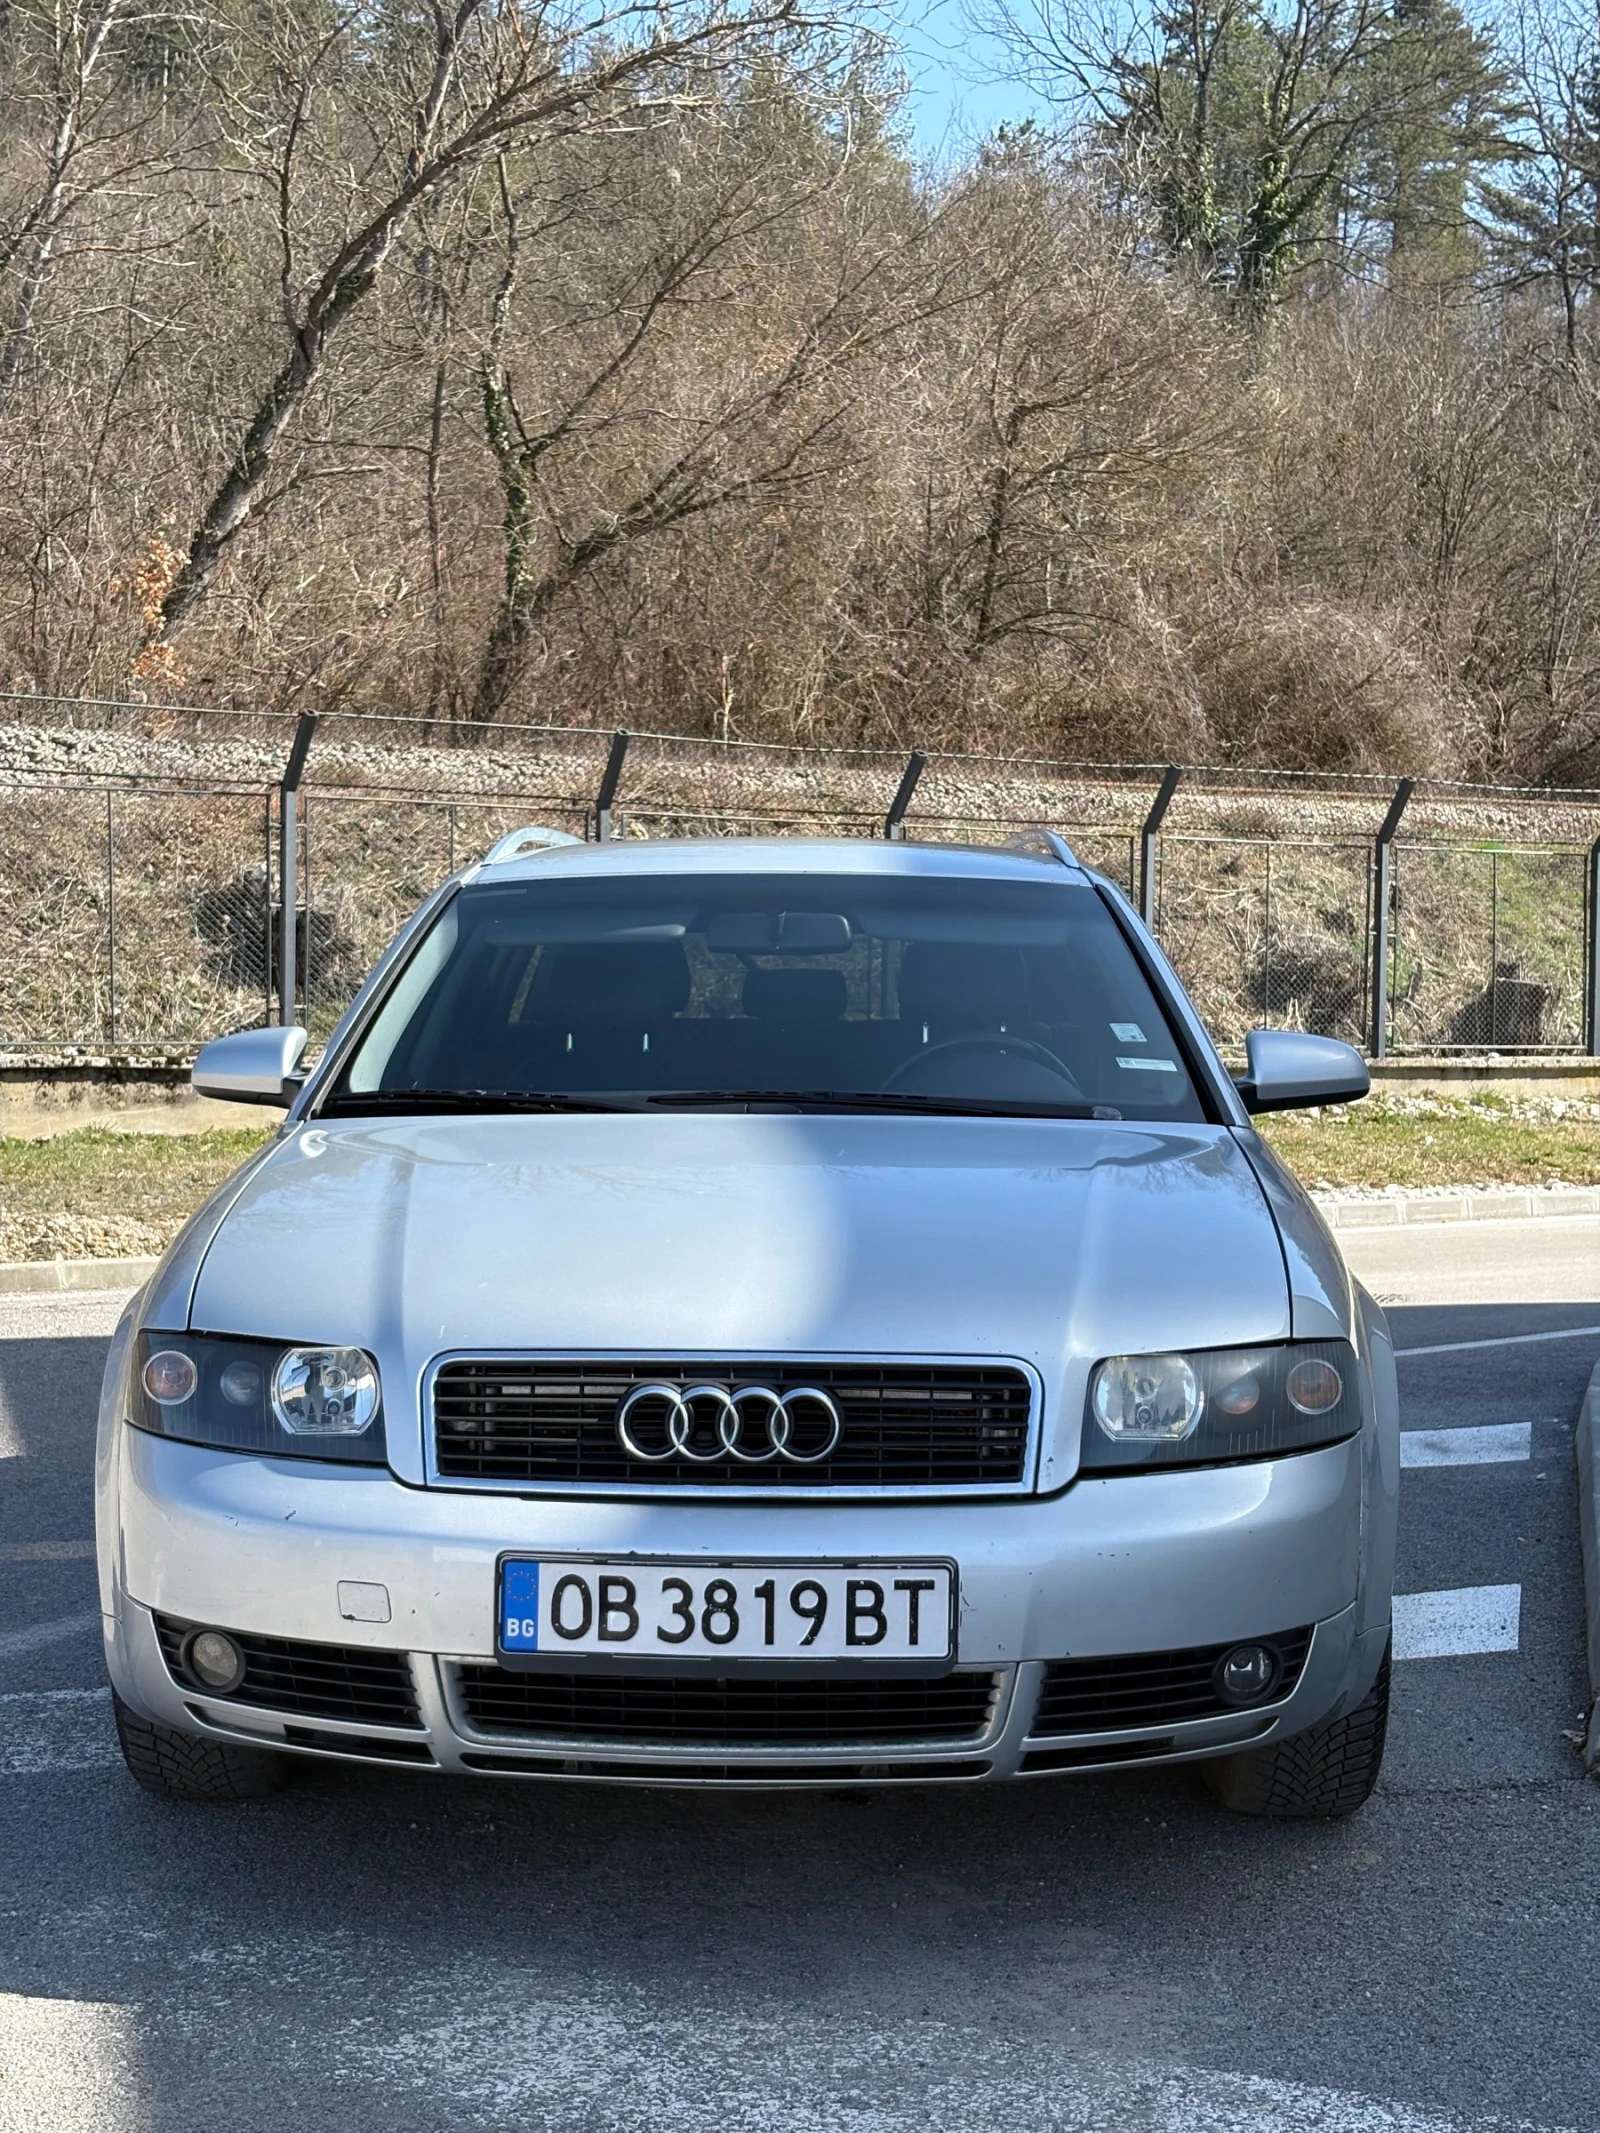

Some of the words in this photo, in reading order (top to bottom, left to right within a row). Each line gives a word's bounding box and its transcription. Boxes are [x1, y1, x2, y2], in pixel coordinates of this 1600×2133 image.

[506, 1617, 535, 1638] BG
[656, 1577, 828, 1646] 3819
[845, 1579, 936, 1647] BT
